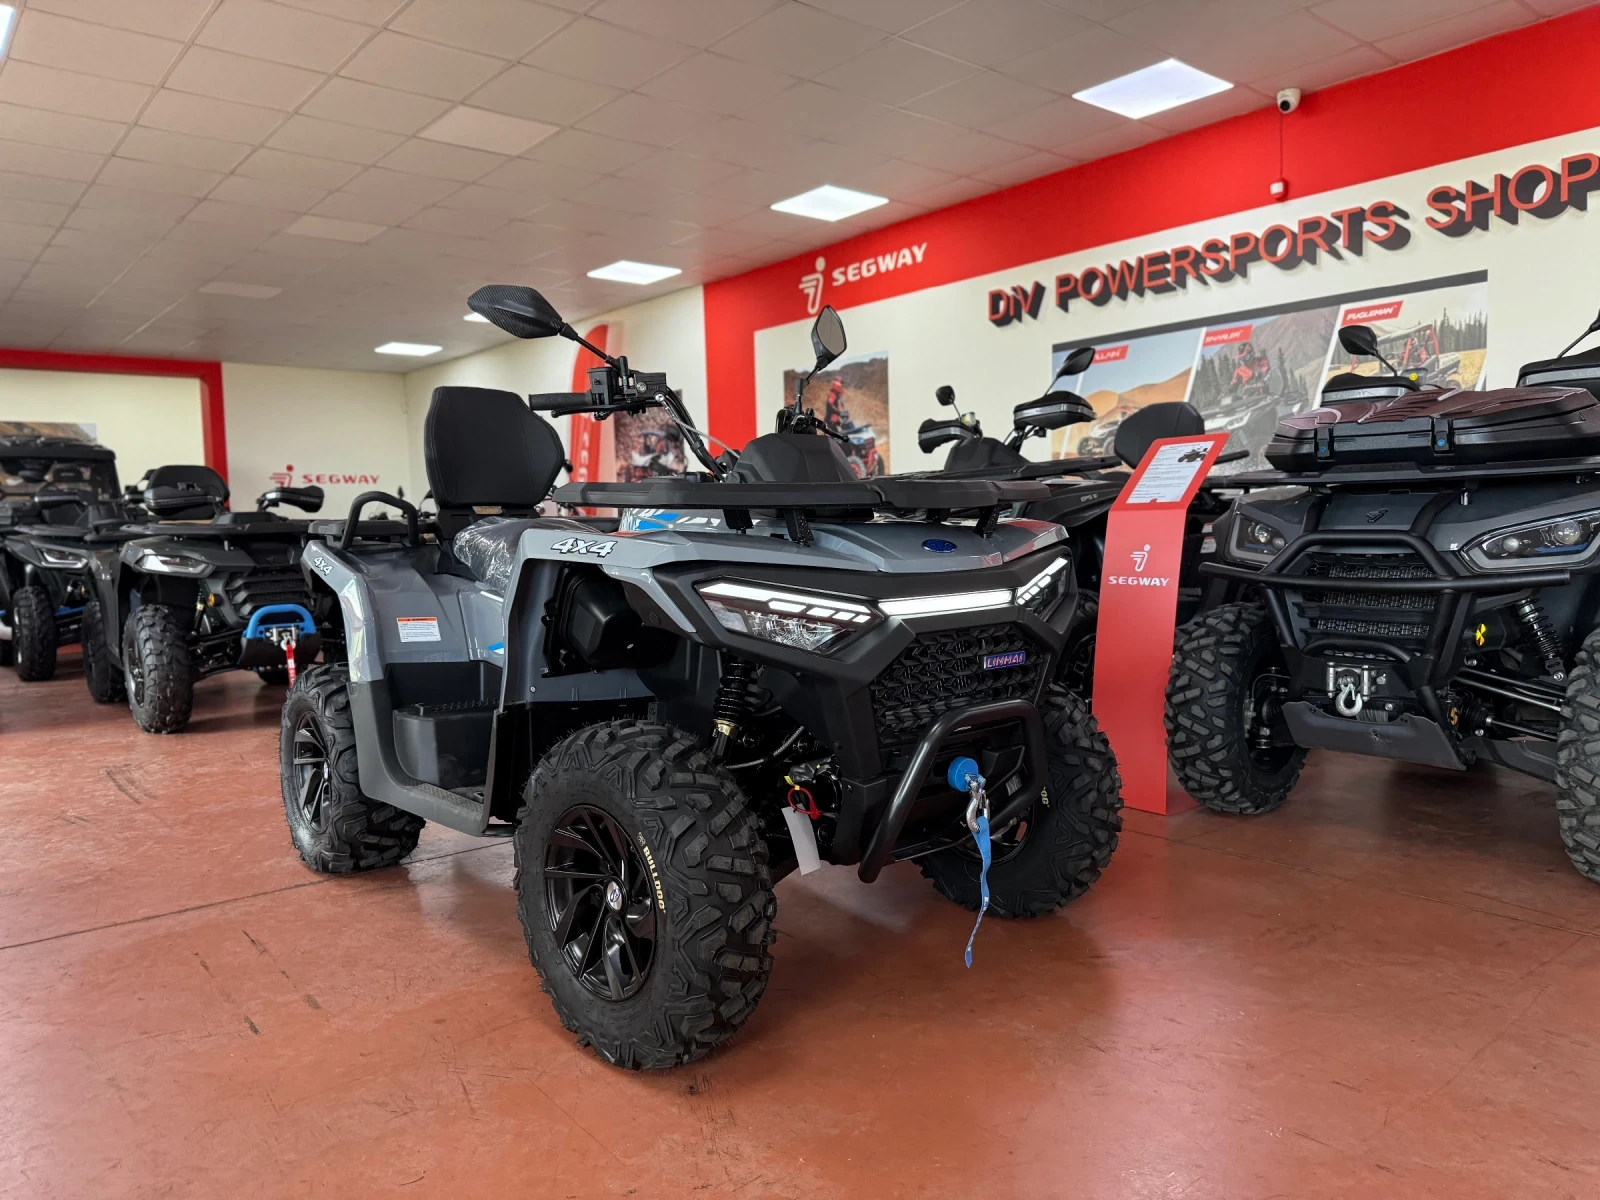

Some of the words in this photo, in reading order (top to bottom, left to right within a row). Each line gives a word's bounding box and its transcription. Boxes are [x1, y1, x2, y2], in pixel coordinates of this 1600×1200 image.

[1055, 200, 1399, 307] POWERSPORTS
[1425, 152, 1600, 230] SHOP
[832, 242, 928, 287] SEGWAY
[1346, 307, 1394, 321] FUGLEMAN
[302, 473, 380, 485] SEGWAY
[1108, 575, 1170, 587] SEGWAY
[986, 653, 1024, 668] LINHAI
[643, 845, 666, 911] BULLDOG
